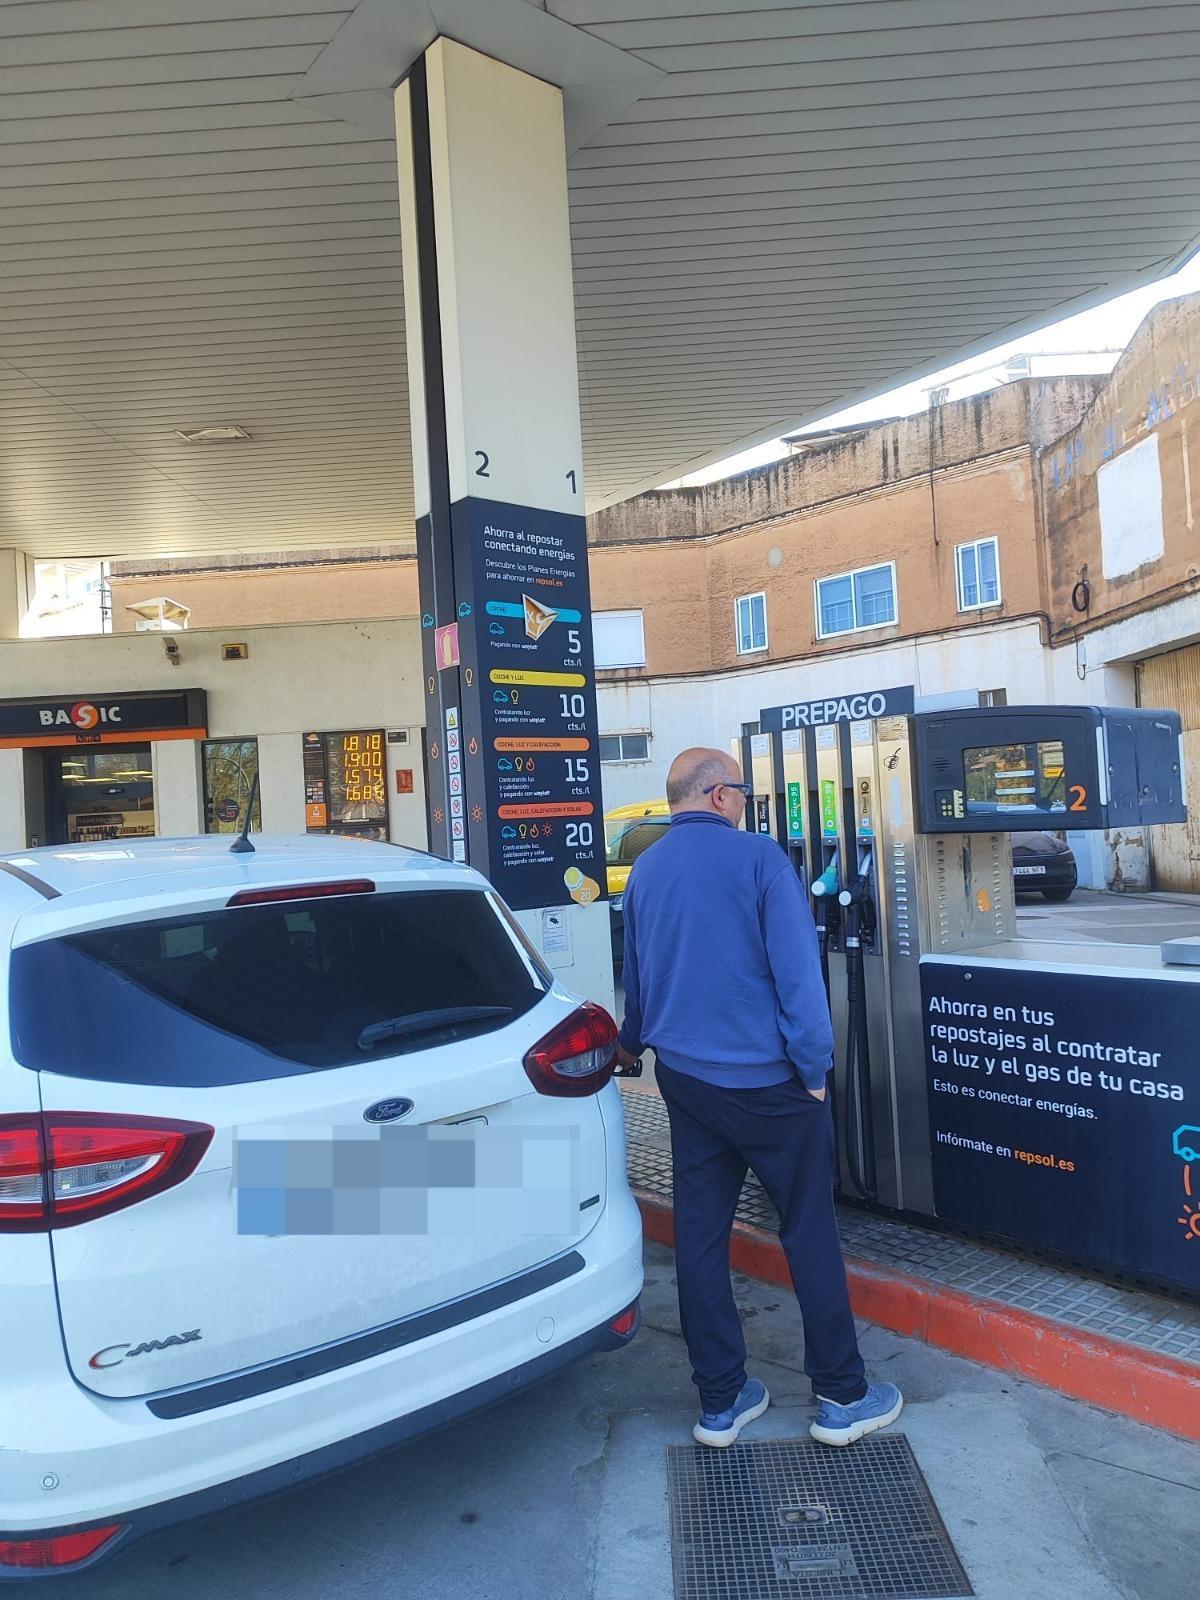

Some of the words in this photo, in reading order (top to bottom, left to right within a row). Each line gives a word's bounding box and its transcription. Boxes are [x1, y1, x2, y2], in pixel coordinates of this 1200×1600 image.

[474, 450, 490, 477] 2
[566, 470, 576, 494] 1
[484, 526, 514, 538] Ahorra
[516, 531, 525, 540] al
[527, 534, 563, 546] repostar
[484, 540, 536, 555] conectando
[486, 559, 516, 570] Descubre
[517, 563, 526, 571] los
[528, 565, 548, 574] Planes
[486, 572, 501, 580] para
[502, 573, 525, 582] ahorrar
[568, 630, 581, 654] 5
[39, 704, 121, 727] BASIC
[560, 694, 585, 718] 10
[781, 693, 886, 729] PREPAGO
[344, 735, 380, 751] 1.818
[344, 752, 381, 767] 1.900
[564, 758, 589, 782] 15
[345, 769, 382, 783] 1.574
[861, 781, 869, 795] 10
[791, 786, 797, 797] 95
[1068, 785, 1087, 811] 2
[565, 822, 593, 847] 20
[928, 996, 988, 1019] Ahorra
[993, 1005, 1016, 1022] en
[1022, 1007, 1054, 1026] tus
[930, 1024, 1026, 1050] repostajes
[1032, 1034, 1051, 1053] al
[1057, 1039, 1161, 1068] contratar
[931, 1045, 948, 1064] la
[953, 1048, 979, 1069] luz
[984, 1056, 995, 1075] y
[1001, 1056, 1019, 1076] el
[1025, 1063, 1060, 1083] gas
[1067, 1066, 1092, 1087] de
[1098, 1071, 1122, 1092] tu
[1129, 1078, 1184, 1101] casa
[376, 1102, 404, 1118] Ford
[934, 1079, 958, 1094] Esto
[961, 1085, 975, 1097] es
[978, 1088, 1033, 1107] conectar
[1036, 1098, 1098, 1119] energías.
[937, 1130, 993, 1154] Infórmate
[996, 1144, 1011, 1158] en
[1014, 1149, 1075, 1172] repsol.es
